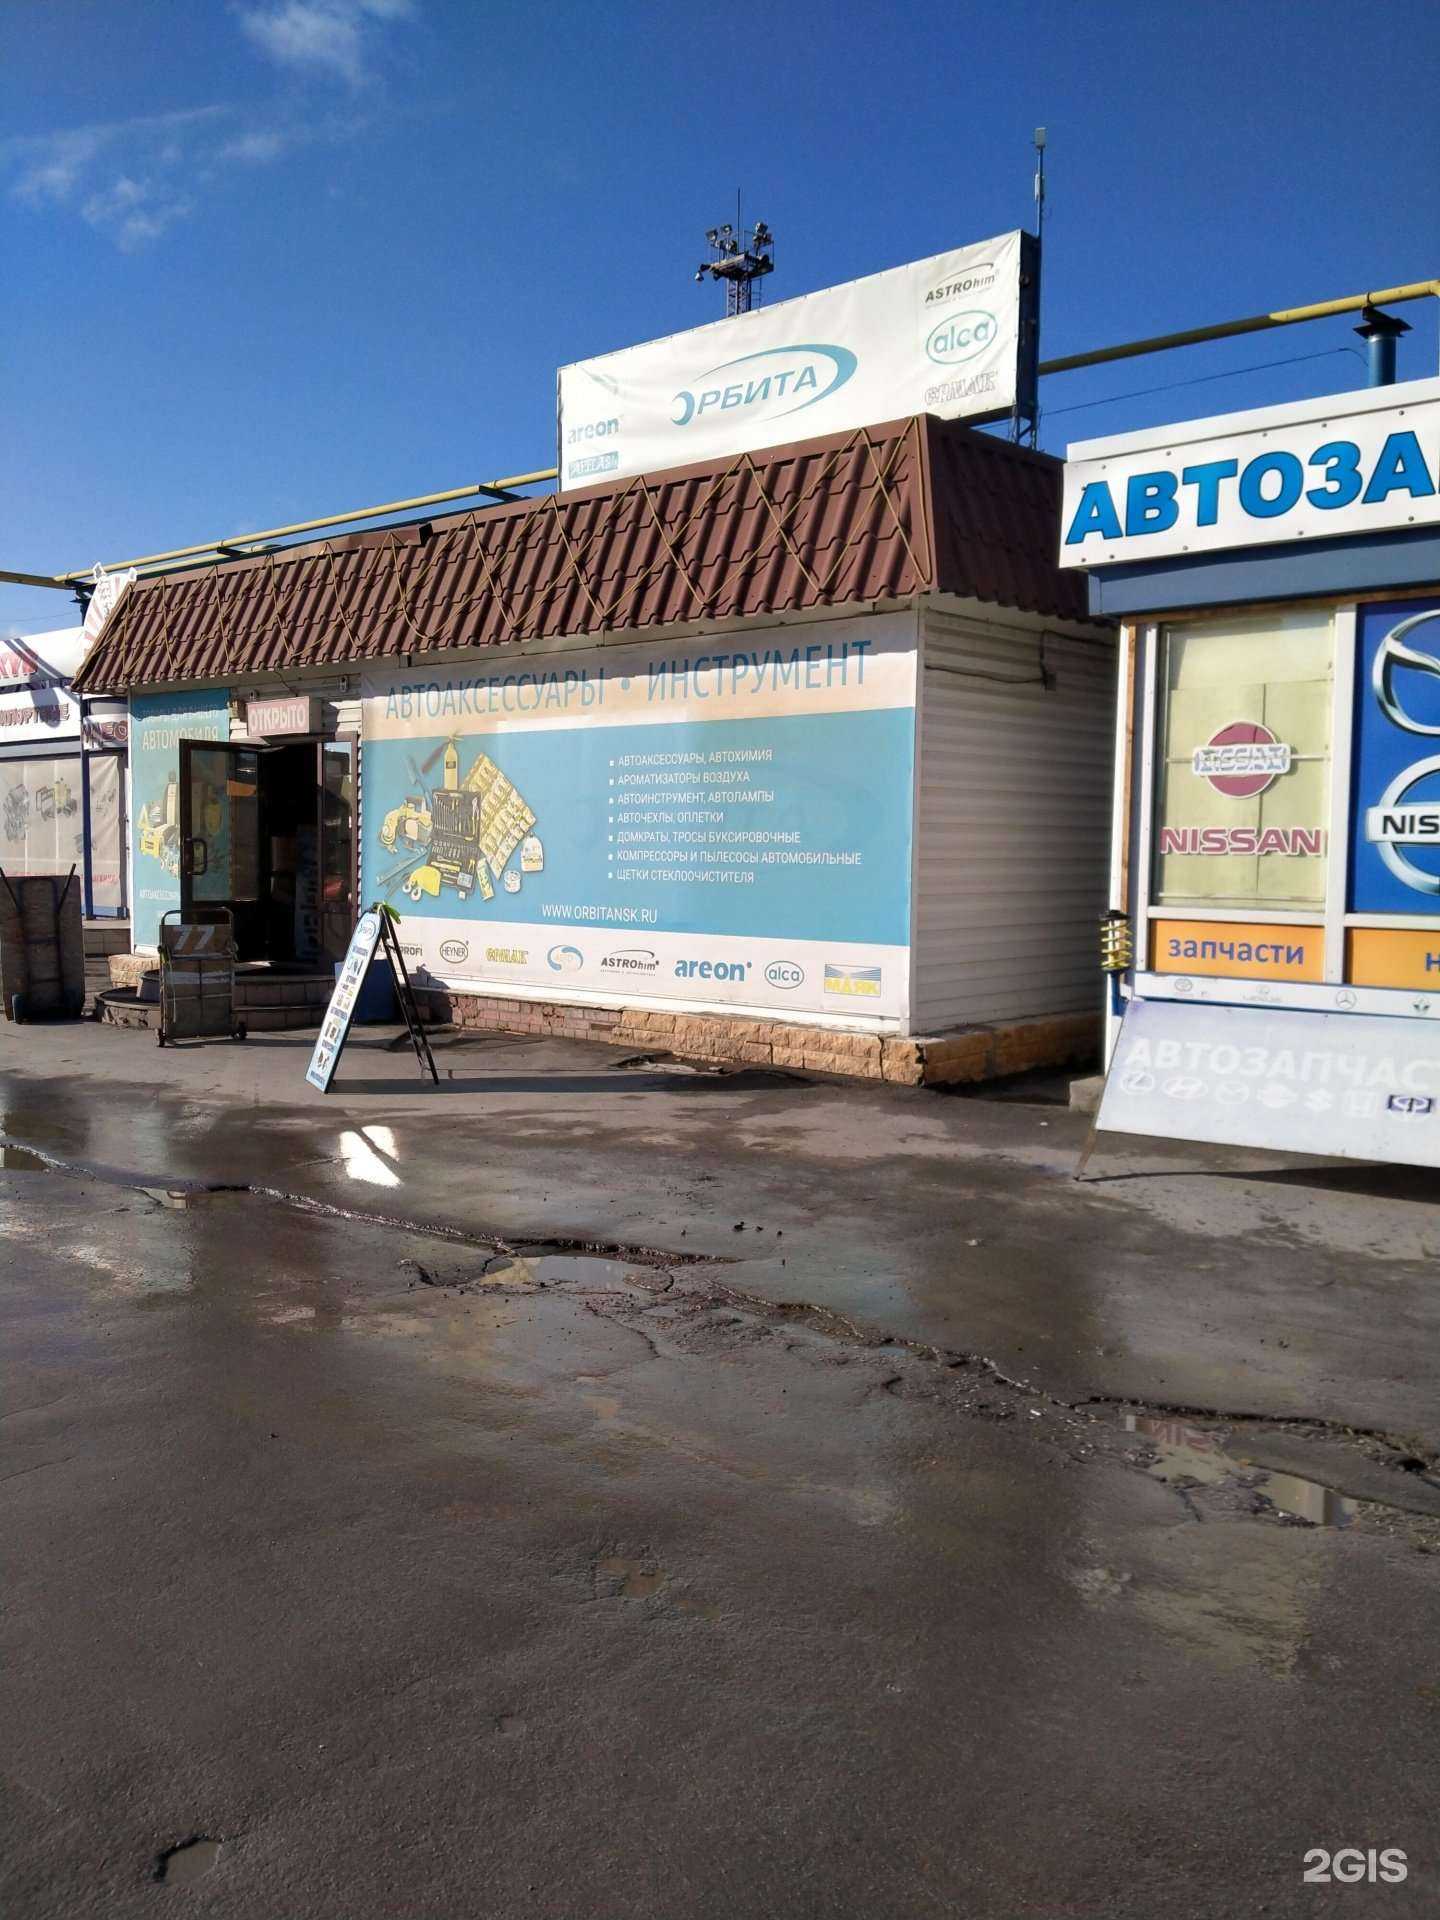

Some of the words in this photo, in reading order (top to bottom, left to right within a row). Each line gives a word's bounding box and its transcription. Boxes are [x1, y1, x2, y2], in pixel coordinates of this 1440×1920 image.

[933, 321, 989, 354] alca
[671, 364, 818, 426] ОРБИТА
[567, 417, 619, 444] areon
[1065, 430, 1440, 546] АВТОЗА
[385, 666, 605, 720] АВТОАКСЕССУАРЫ
[647, 640, 873, 702] ИНСТРУМЕНТ
[250, 704, 306, 730] ОТКРЫТО
[708, 749, 773, 764] АВТОХИМИЯ
[617, 772, 701, 786] АРОМАТИЗАТОРЫ
[703, 771, 751, 785] ВОЗДУХА
[708, 790, 774, 803] АВТОЛАМПЫ
[677, 811, 724, 824] ОПЛЕТКИ
[672, 831, 708, 844] ТРОСЫ
[708, 831, 801, 844] БУКСИРОВОЧНЫЕ
[1159, 827, 1323, 856] NISSAN
[616, 850, 689, 863] КОМПРЕССОРЫ
[690, 850, 698, 863] И
[700, 851, 759, 864] ПЫЛЕСОСЫ
[761, 852, 862, 866] АВТОМОБИЛЬНЫЕ
[616, 869, 650, 882] ЩЕТКИ
[650, 870, 755, 884] СТЕКЛООЧИСТИТЕЛЯ
[541, 903, 658, 925] WWW.ORBITANSK.RU
[1168, 936, 1305, 966] запчасти
[674, 959, 745, 982] areon
[768, 965, 800, 982] alca
